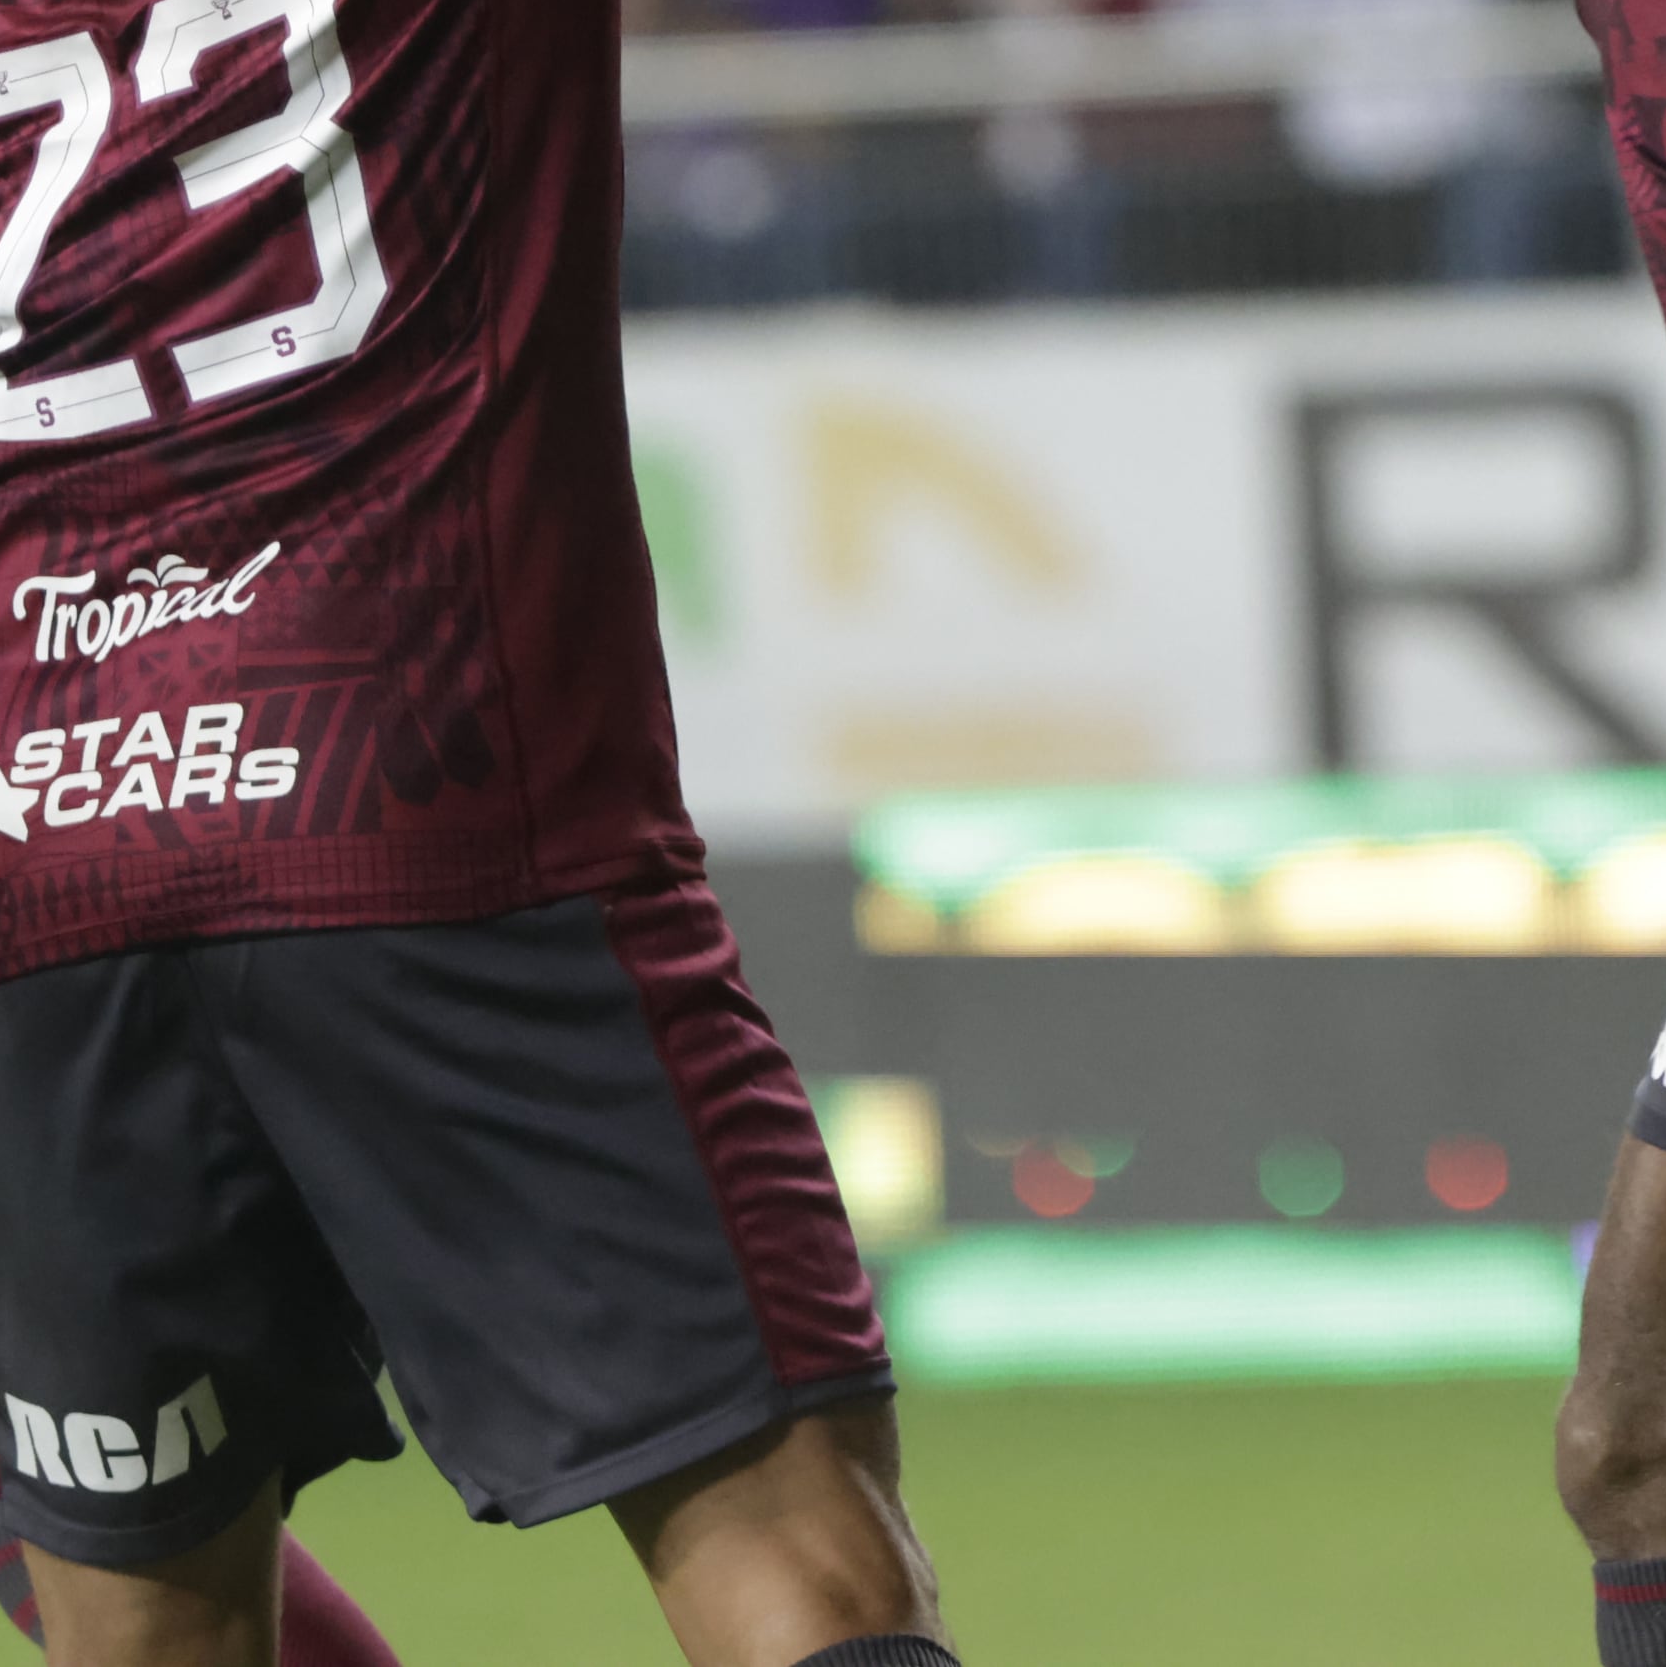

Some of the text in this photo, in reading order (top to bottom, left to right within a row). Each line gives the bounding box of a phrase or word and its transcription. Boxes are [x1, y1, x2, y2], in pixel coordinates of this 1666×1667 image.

[270, 325, 297, 358] S
[35, 396, 56, 428] S
[13, 540, 281, 664] Tropical
[9, 701, 244, 784] STAR
[43, 746, 300, 828] CARS
[4, 1372, 228, 1494] RCA
